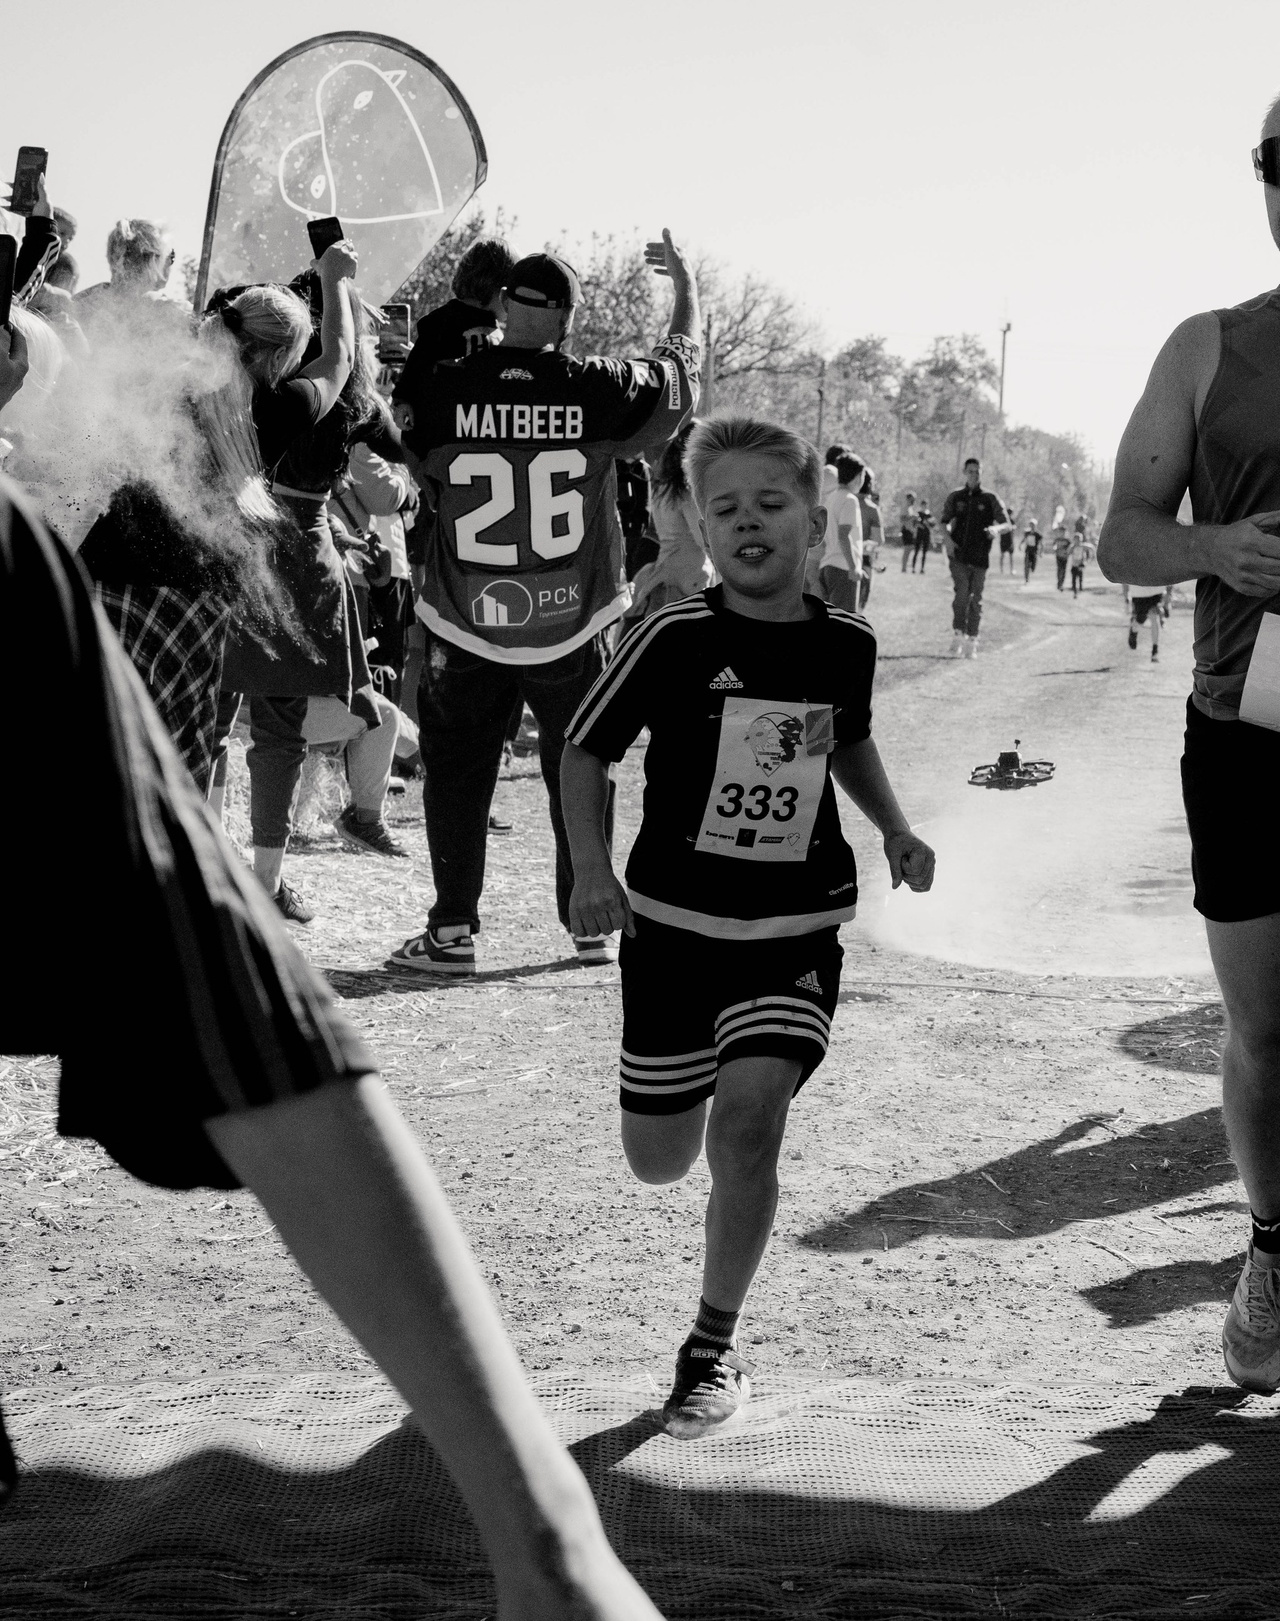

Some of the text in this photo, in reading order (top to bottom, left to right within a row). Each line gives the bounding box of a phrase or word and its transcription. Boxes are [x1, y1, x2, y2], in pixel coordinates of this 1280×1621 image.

[456, 404, 583, 439] МАТВЕЕВ
[448, 448, 588, 566] 26
[539, 583, 579, 607] РСК
[709, 680, 744, 690] adidas
[716, 783, 799, 823] 333
[795, 980, 823, 995] adidas
